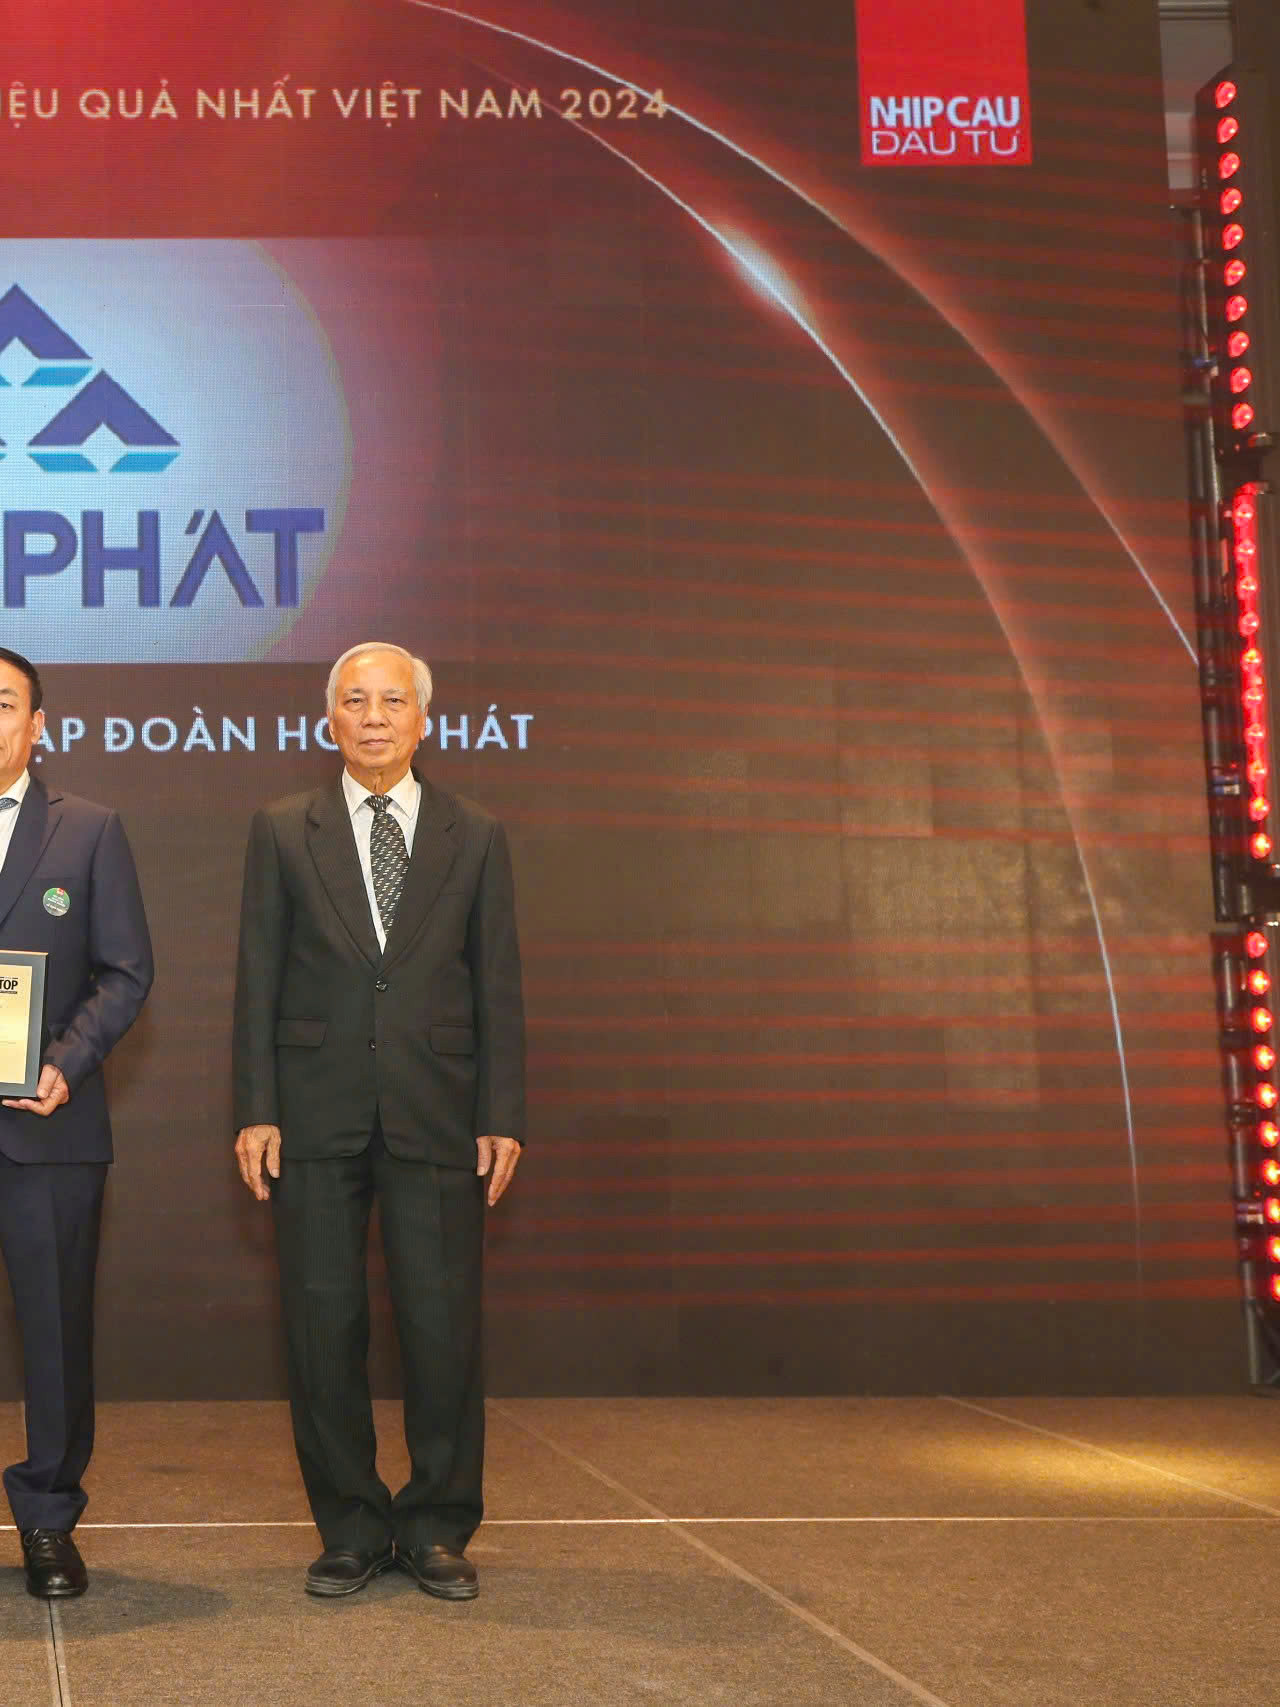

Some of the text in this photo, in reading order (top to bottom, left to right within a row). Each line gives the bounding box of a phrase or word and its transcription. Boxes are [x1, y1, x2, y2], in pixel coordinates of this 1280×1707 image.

[78, 79, 178, 119] QUẢ
[195, 74, 317, 119] NHẤT
[332, 81, 421, 128] VIỆT
[439, 89, 543, 119] NAM
[559, 88, 667, 119] 2024
[3, 507, 325, 608] PHÁT
[104, 707, 256, 753] ĐOÀN
